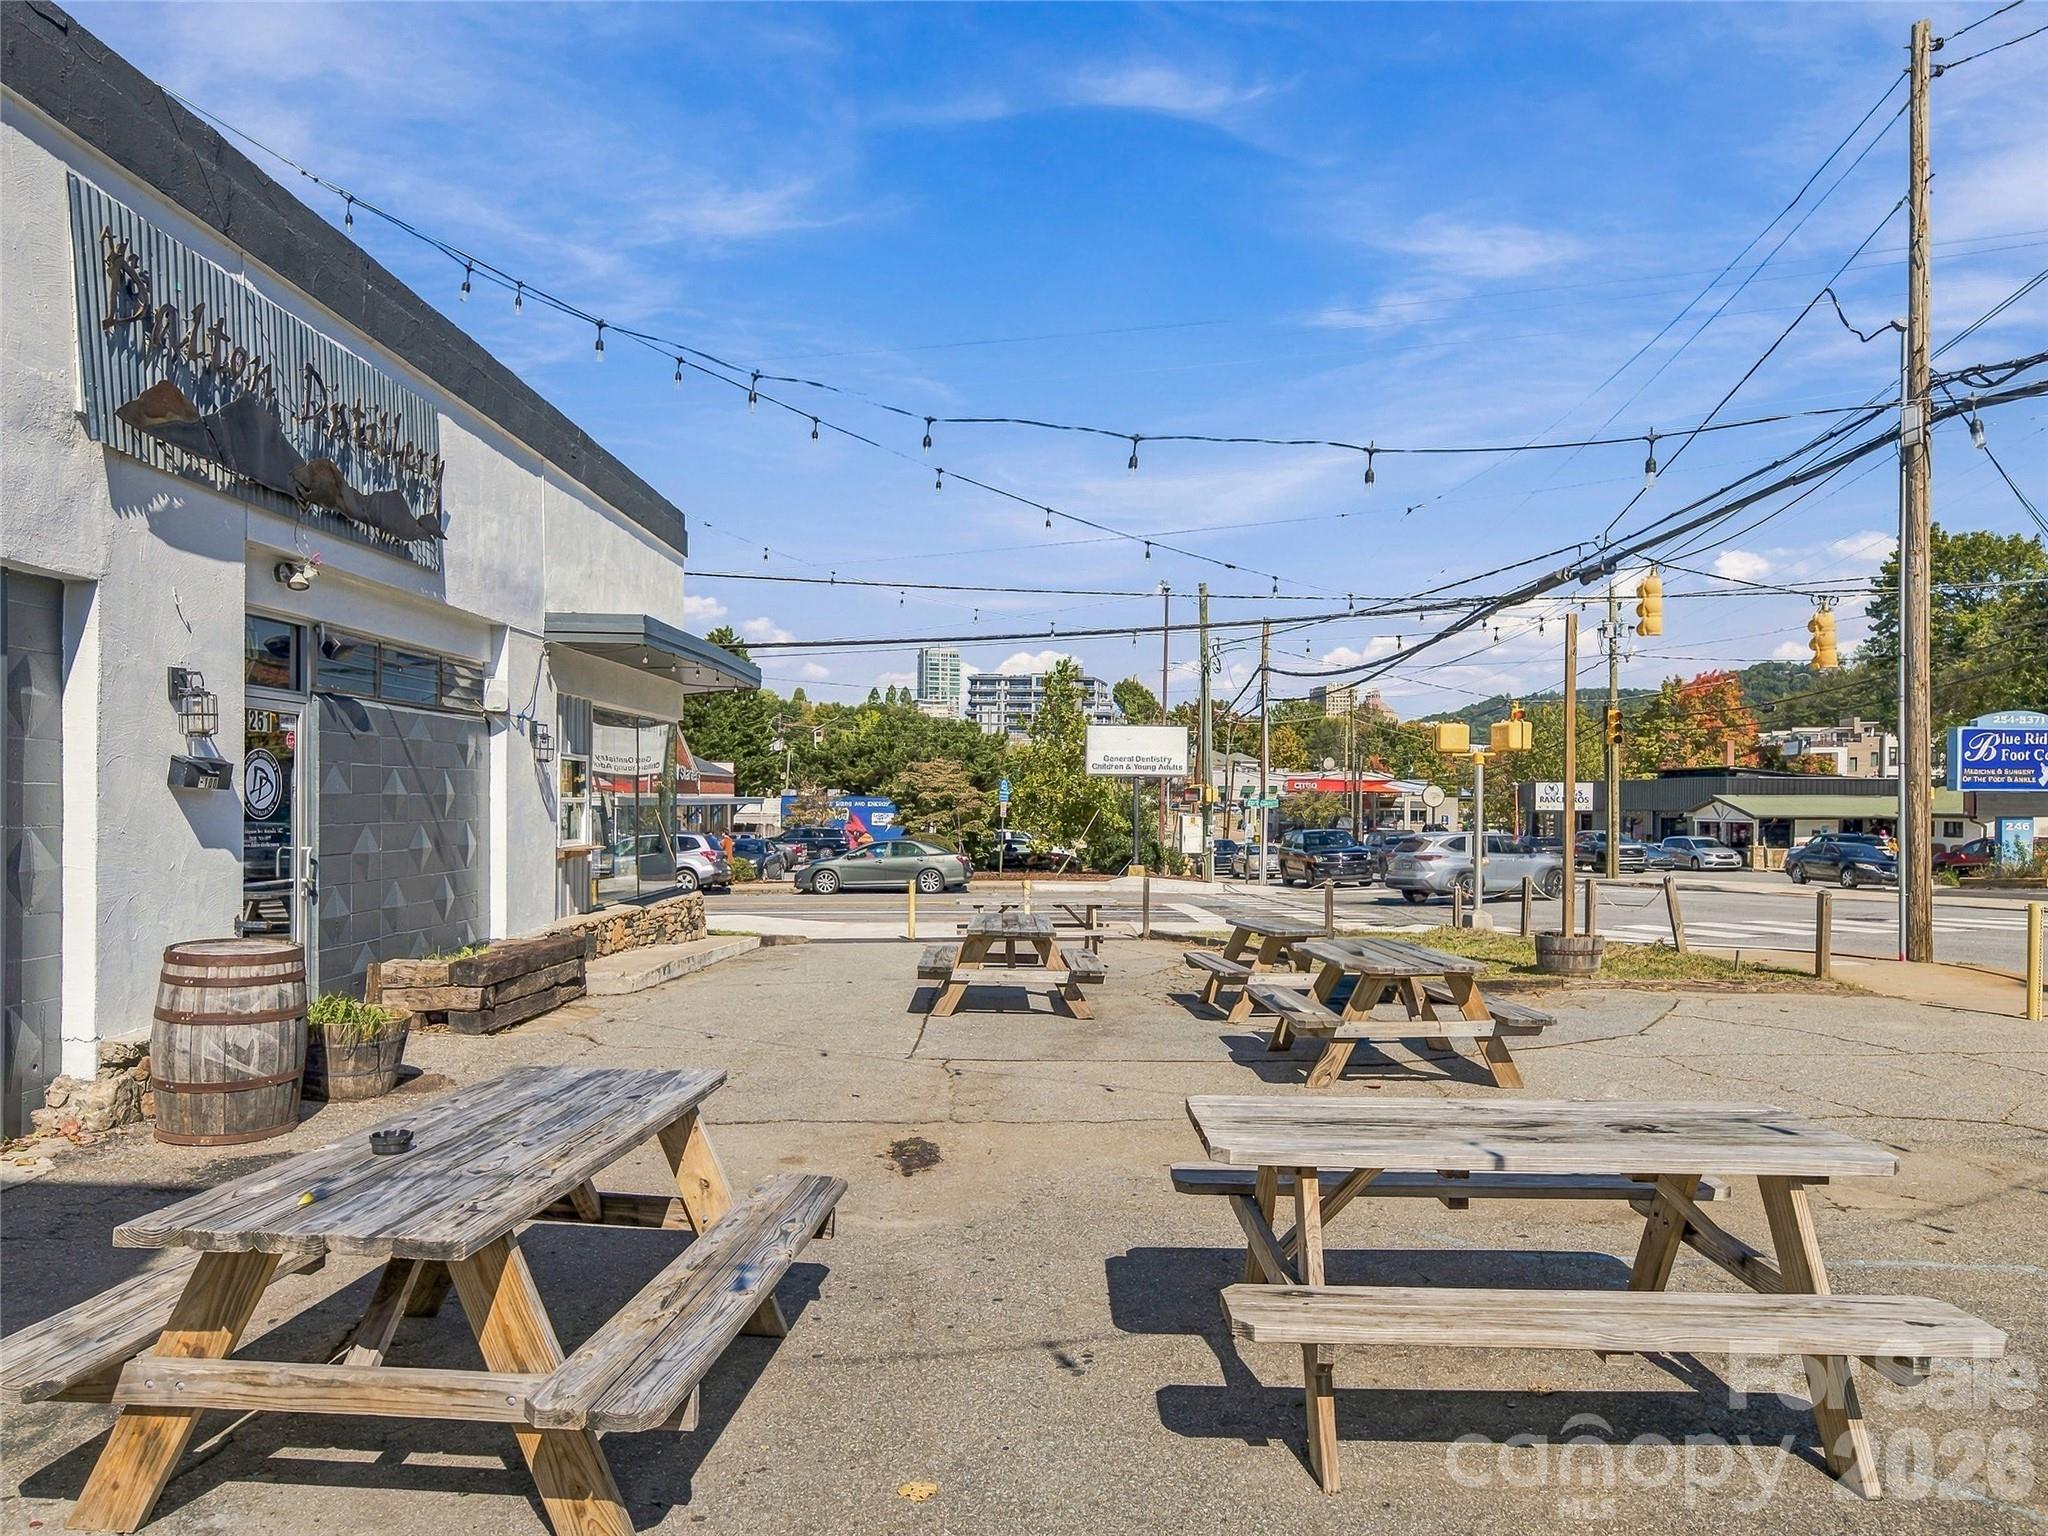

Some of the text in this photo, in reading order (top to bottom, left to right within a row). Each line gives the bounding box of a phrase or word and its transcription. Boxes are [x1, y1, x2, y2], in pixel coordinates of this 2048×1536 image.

[102, 252, 275, 399] Dalton
[1964, 732, 2021, 762] Blue
[1103, 754, 1172, 764] General Dentistry
[2001, 748, 2031, 761] Foot
[1133, 763, 1157, 772] Young
[1158, 763, 1183, 771] Adults
[1539, 796, 1590, 804] RANCOS
[2006, 822, 2030, 831] 246
